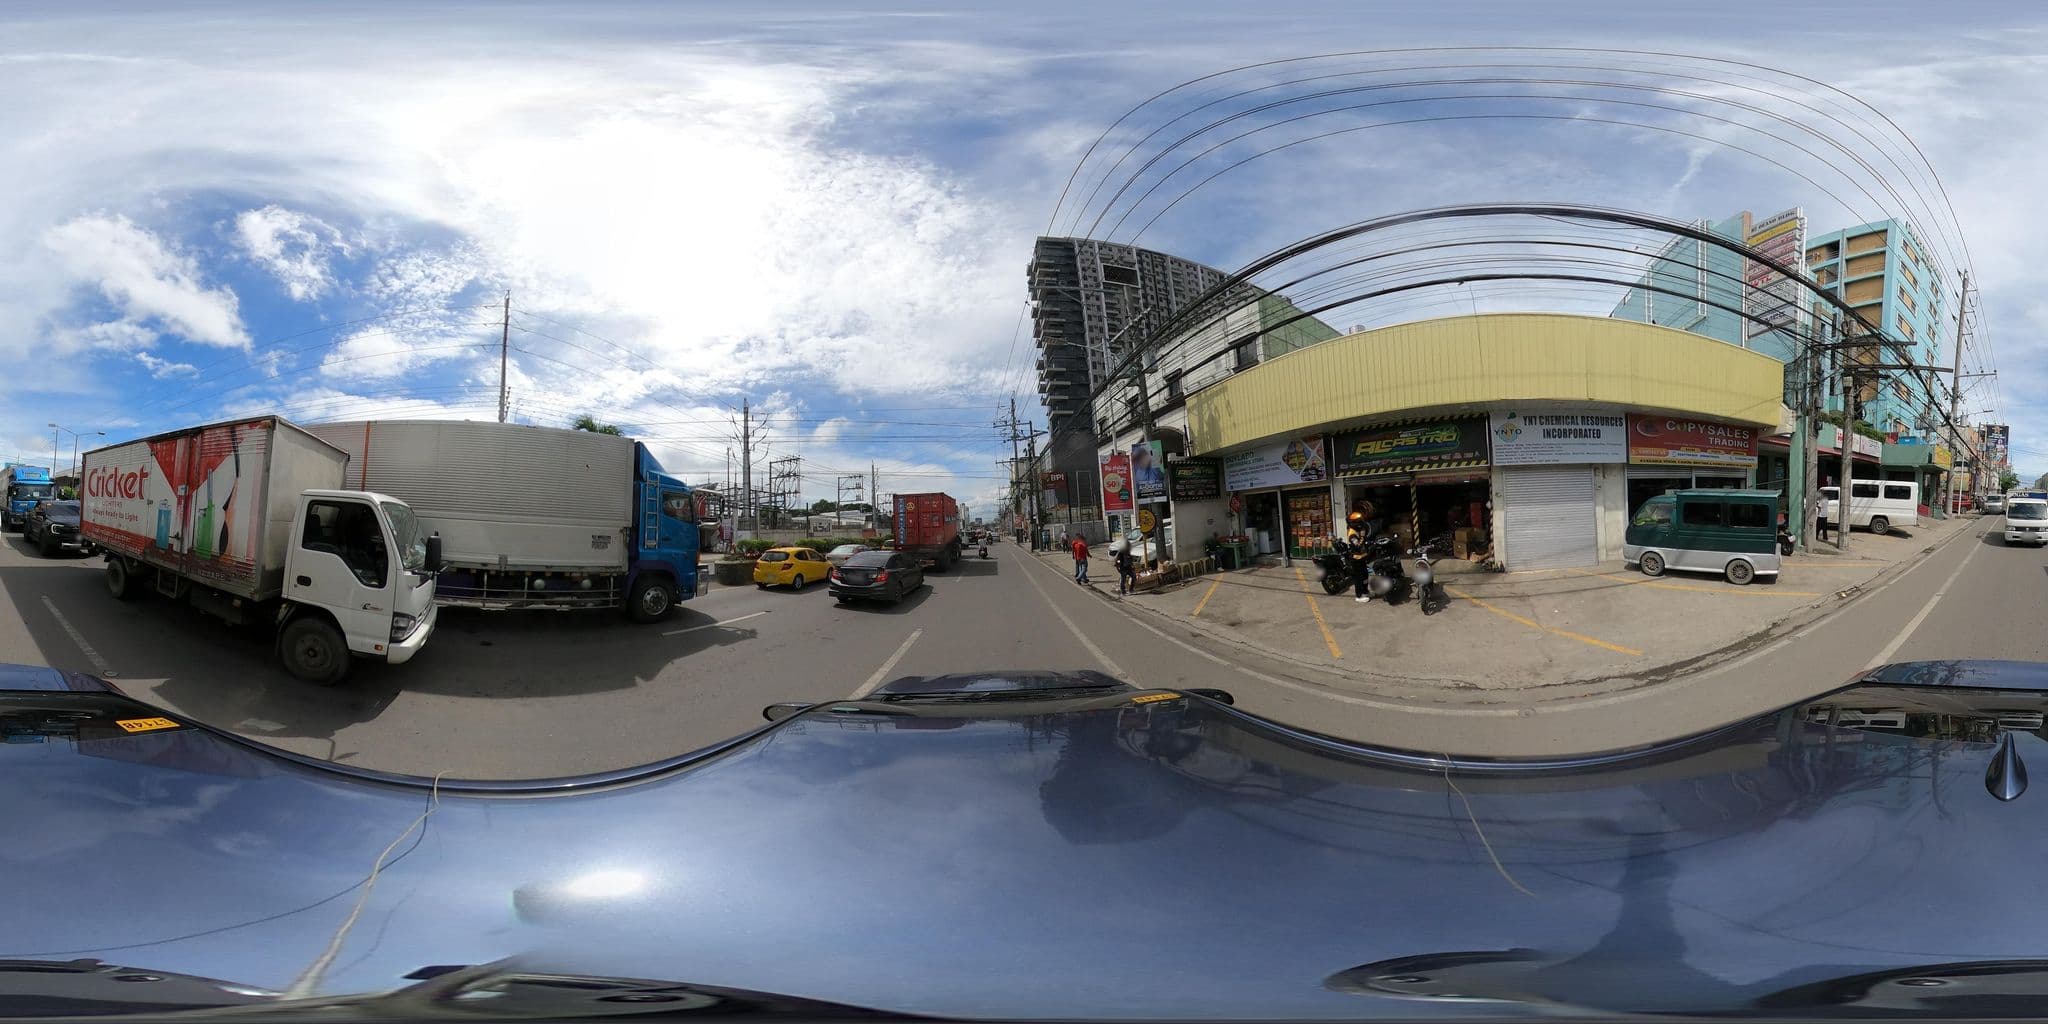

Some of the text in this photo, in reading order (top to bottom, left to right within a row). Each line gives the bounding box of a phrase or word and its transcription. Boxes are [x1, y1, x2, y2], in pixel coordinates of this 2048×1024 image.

[1538, 415, 1580, 427] CHEMICAL
[1581, 415, 1624, 428] RESOURCES
[1543, 427, 1602, 440] INCORPORATED
[1665, 420, 1751, 440] COPYSALES
[1708, 436, 1750, 449] TRADING
[88, 465, 149, 500] Cricket
[124, 512, 139, 522] Light
